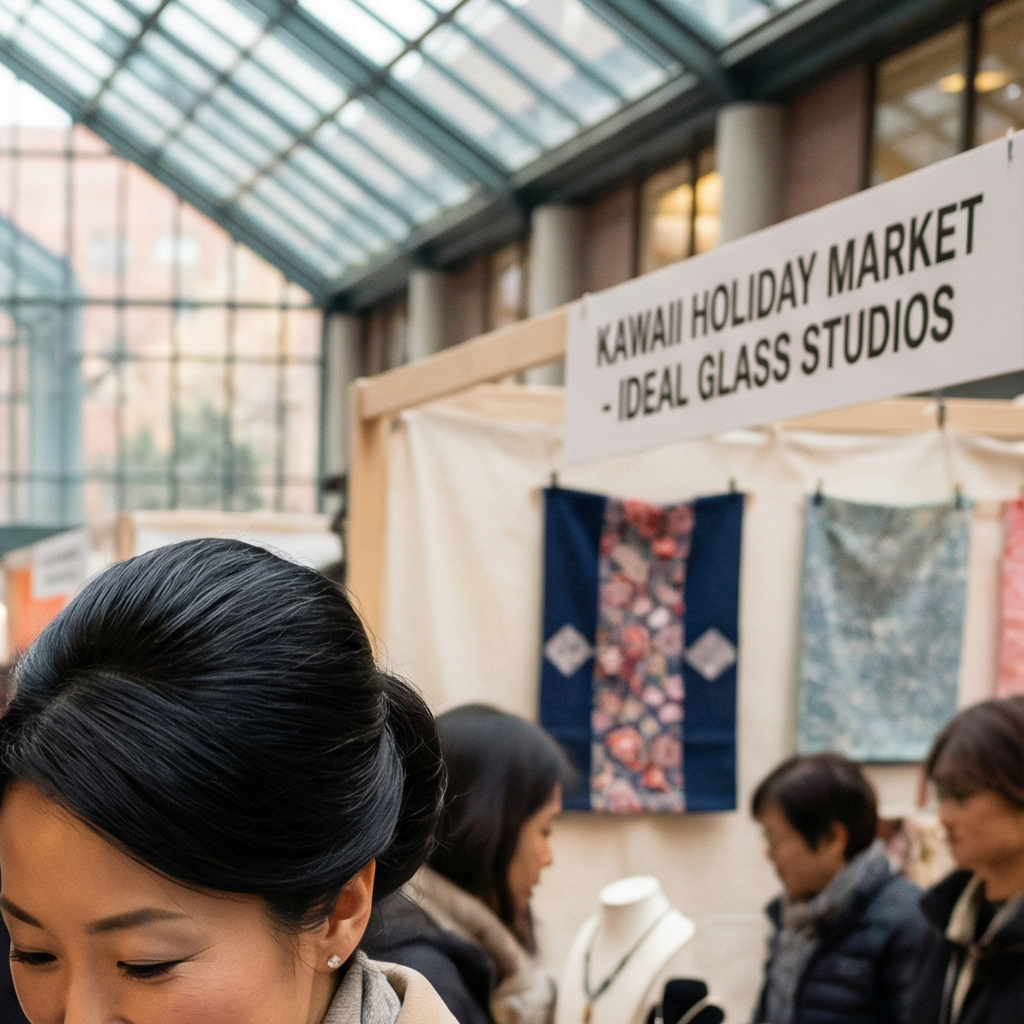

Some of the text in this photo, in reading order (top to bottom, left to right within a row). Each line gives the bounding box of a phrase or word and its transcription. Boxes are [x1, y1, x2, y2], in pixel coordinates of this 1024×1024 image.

[596, 193, 984, 367] KAWAII HOLIDAY MARKET
[697, 332, 791, 402] GLASS
[801, 284, 955, 375] STUDIOS
